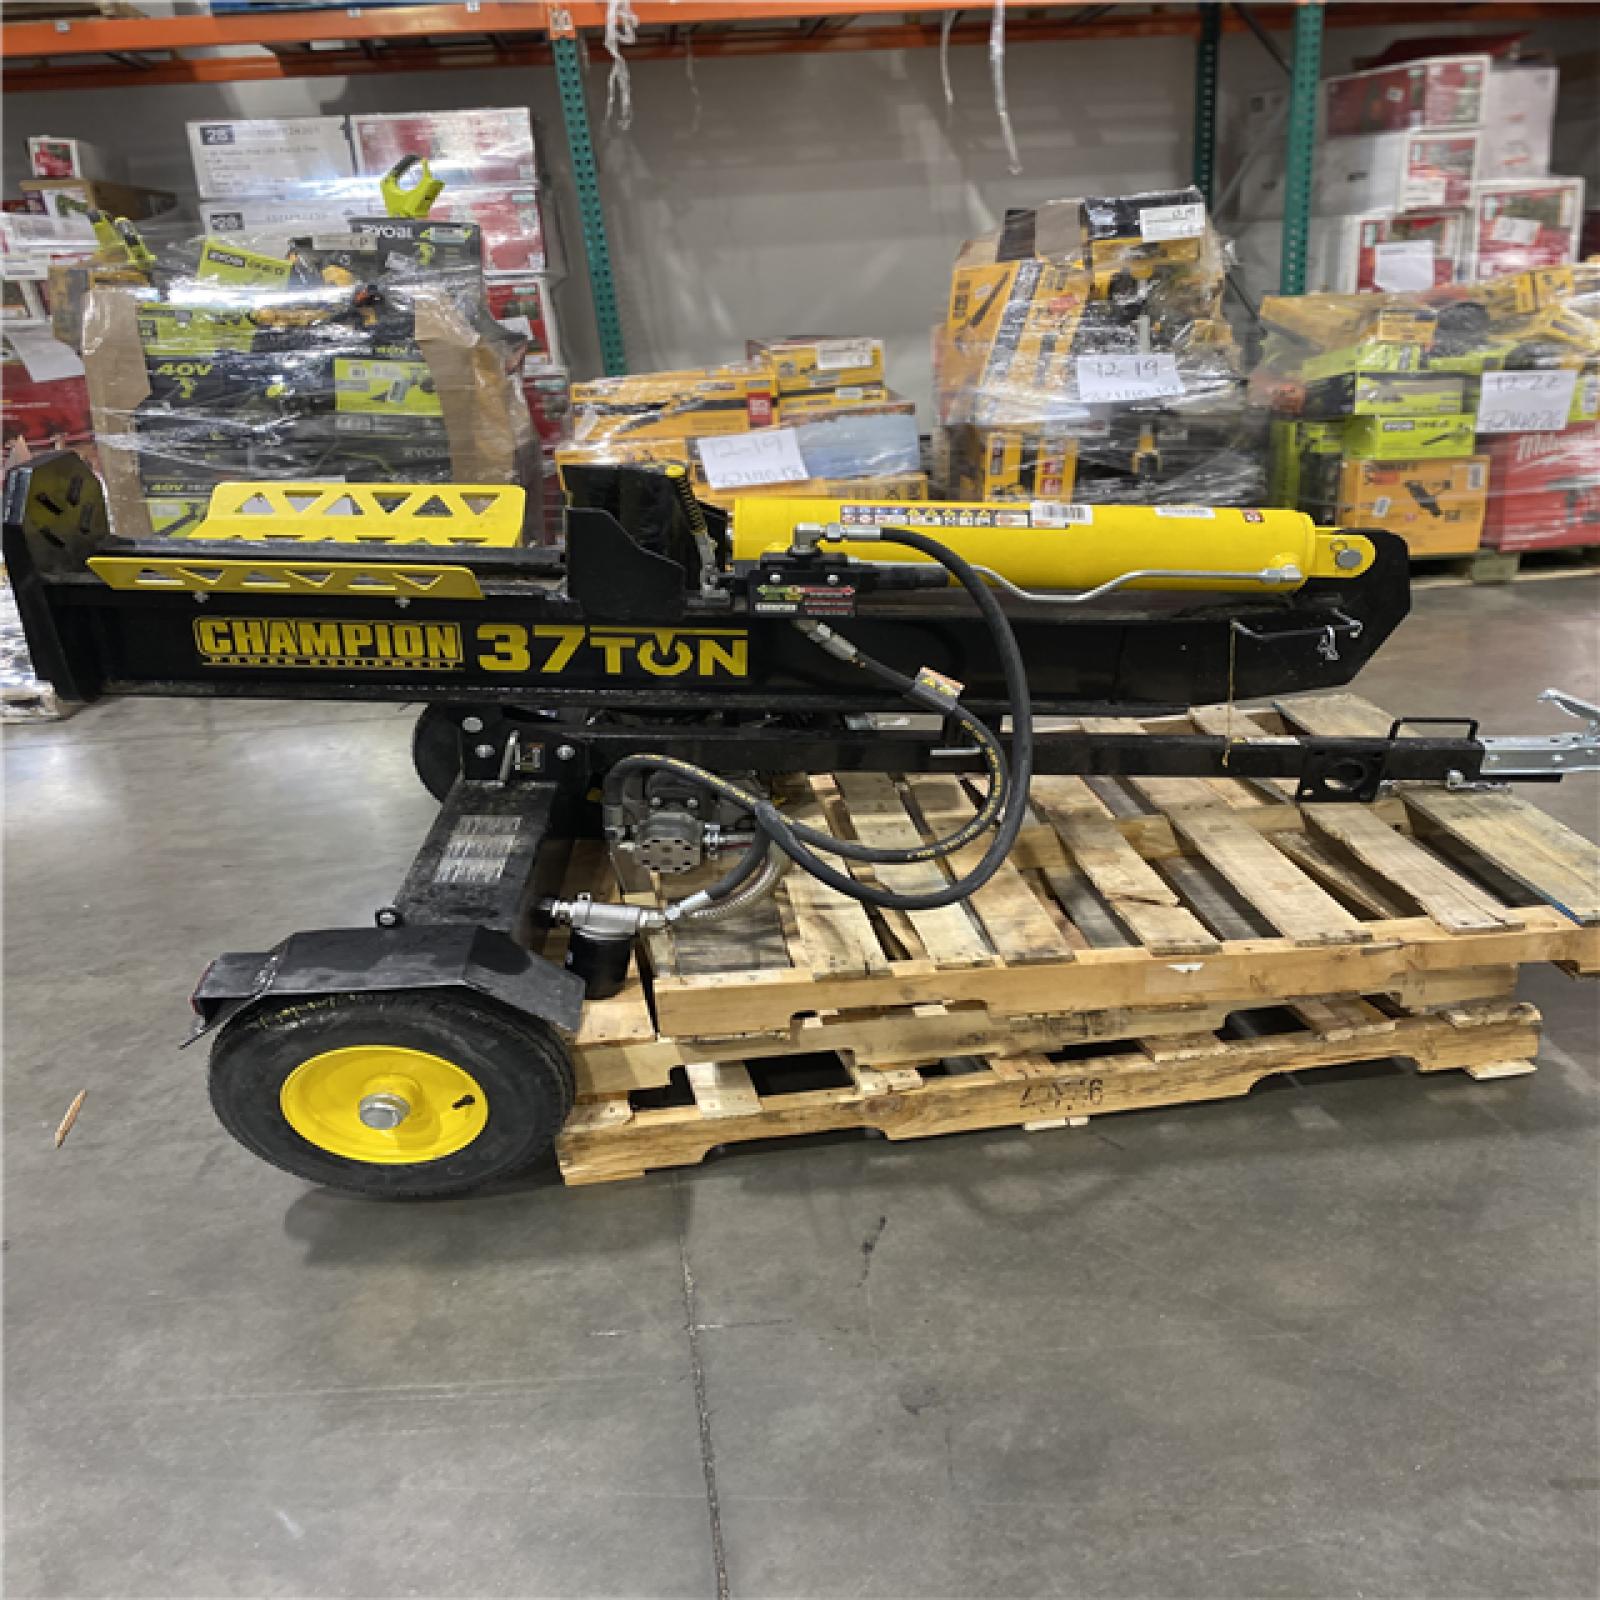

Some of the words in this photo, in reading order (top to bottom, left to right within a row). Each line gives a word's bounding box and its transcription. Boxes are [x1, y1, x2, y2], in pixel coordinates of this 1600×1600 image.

[155, 363, 214, 377] 40V
[198, 618, 458, 660] CHAMPION
[477, 624, 588, 674] 37
[589, 626, 748, 678] TON
